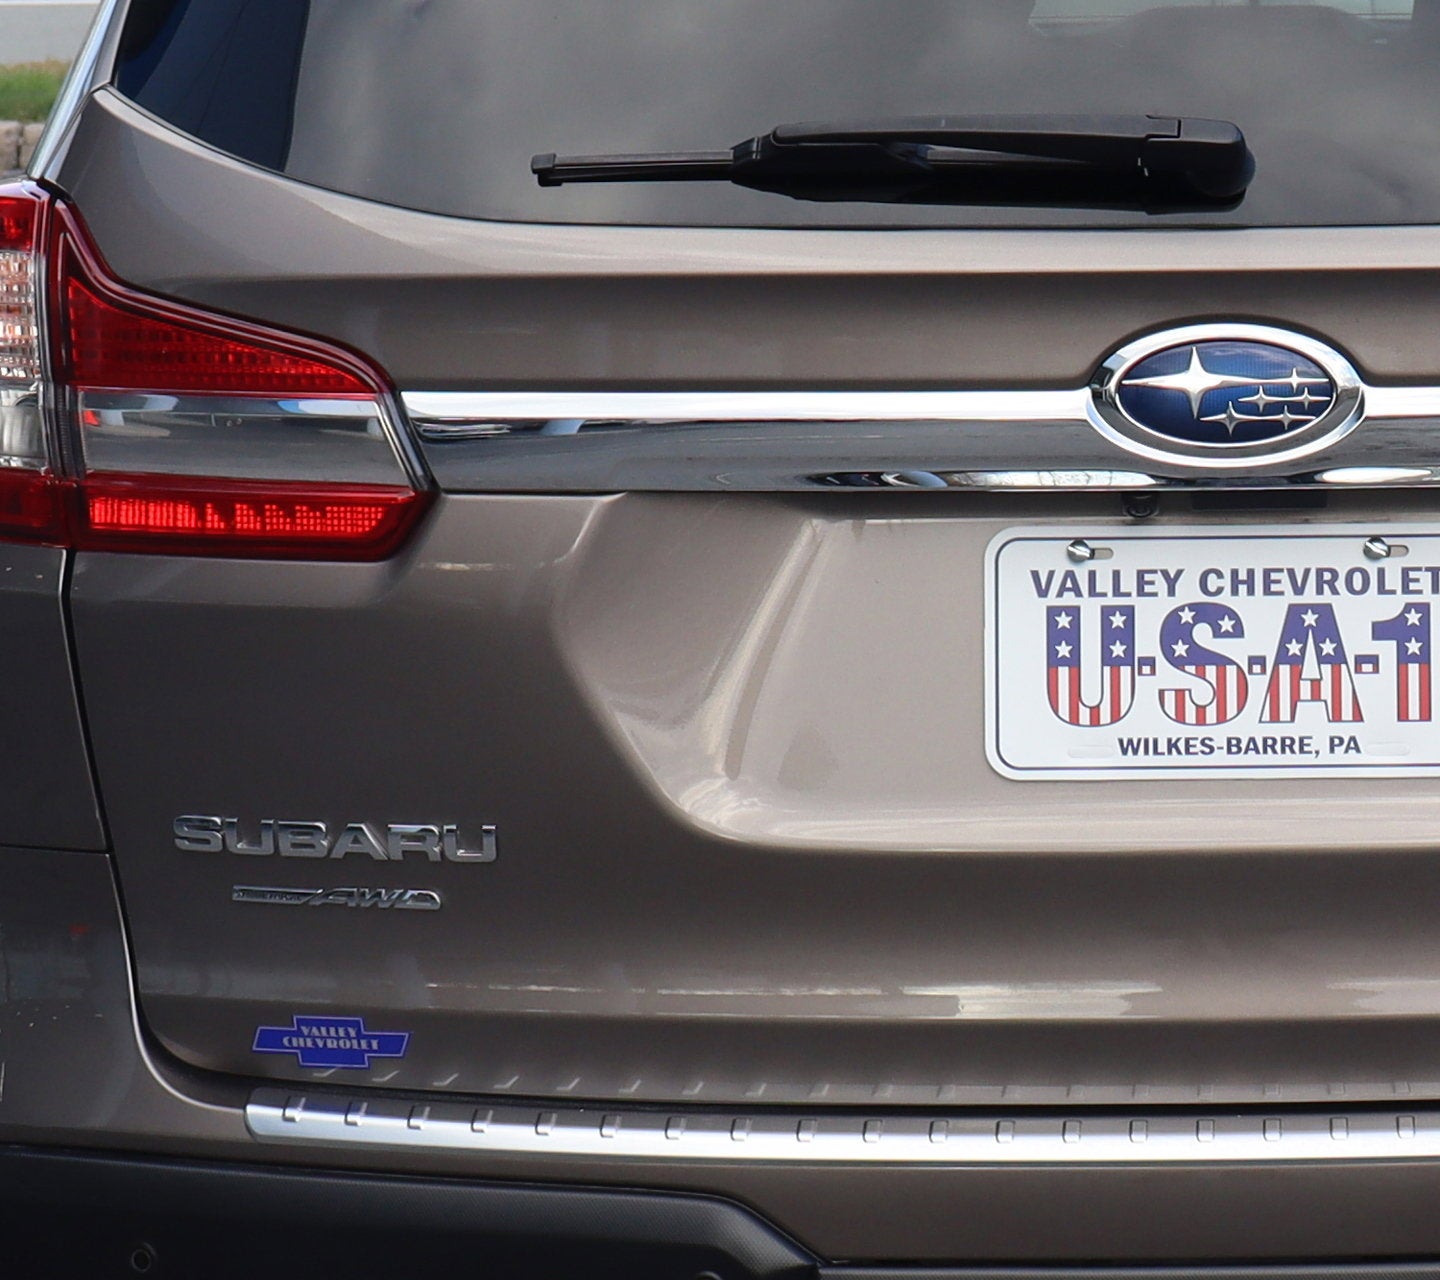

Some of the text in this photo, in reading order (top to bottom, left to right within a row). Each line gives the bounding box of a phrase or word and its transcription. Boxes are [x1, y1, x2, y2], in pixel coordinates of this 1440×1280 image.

[1030, 568, 1185, 599] VALLEY
[1117, 735, 1362, 760] WILKES-BARRE, PA
[172, 814, 498, 863] SUBARU
[309, 886, 442, 911] AWD
[282, 1036, 379, 1050] CHEVROLET
[300, 1025, 358, 1038] VALLEY
